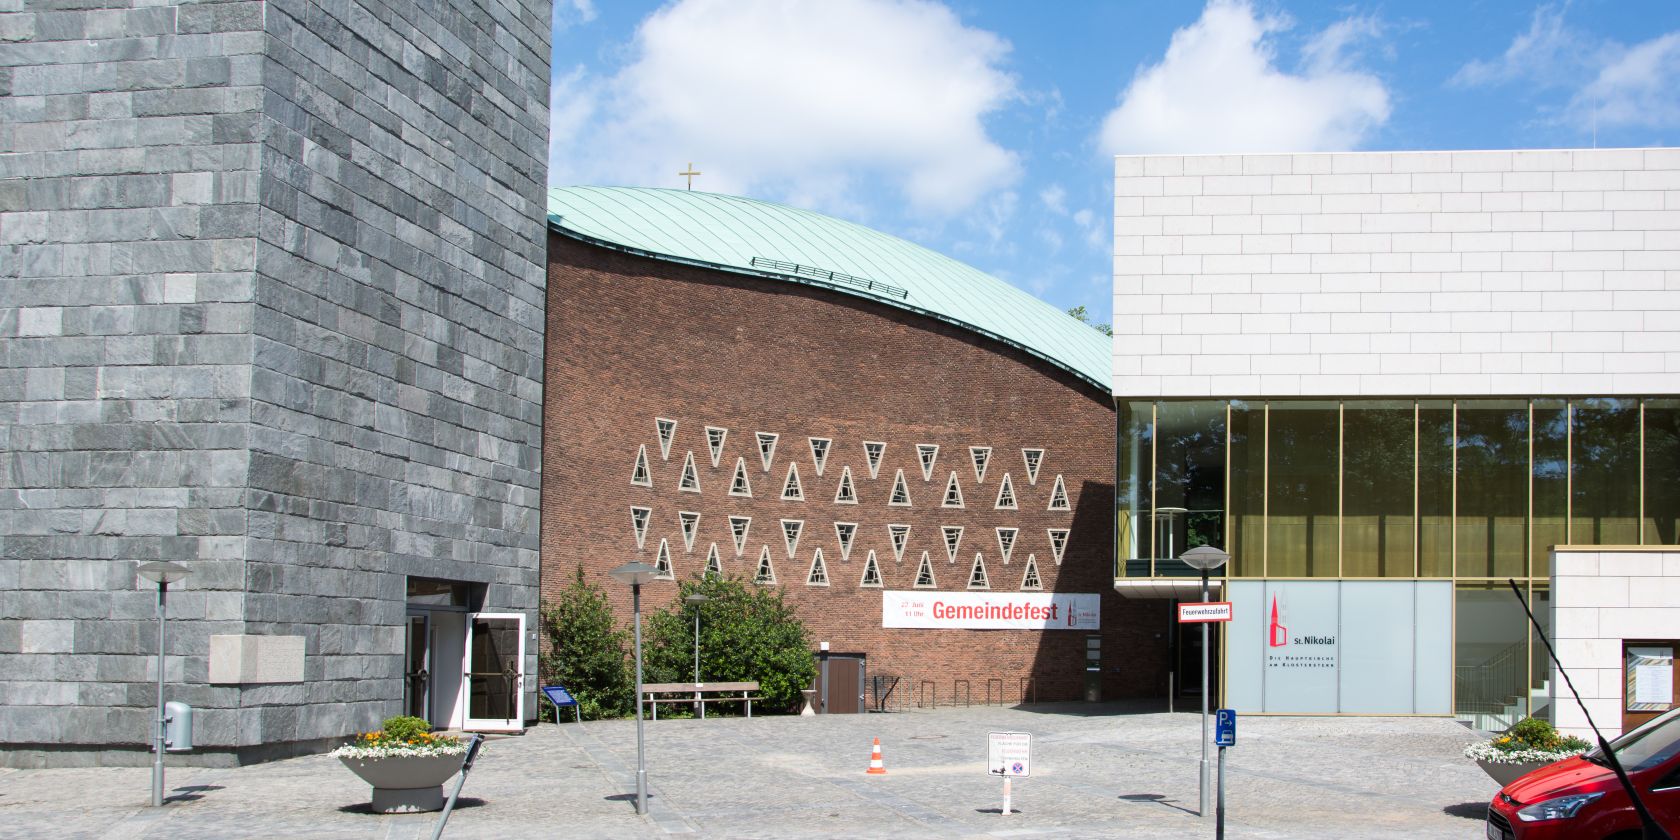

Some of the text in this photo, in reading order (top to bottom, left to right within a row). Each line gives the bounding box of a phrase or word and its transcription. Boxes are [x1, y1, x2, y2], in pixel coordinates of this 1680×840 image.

[933, 601, 1058, 620] Gemeindefest
[1182, 608, 1229, 616] Feuerwehrzufahrt
[1294, 636, 1335, 645] St. Nikolai
[1219, 711, 1228, 726] P
